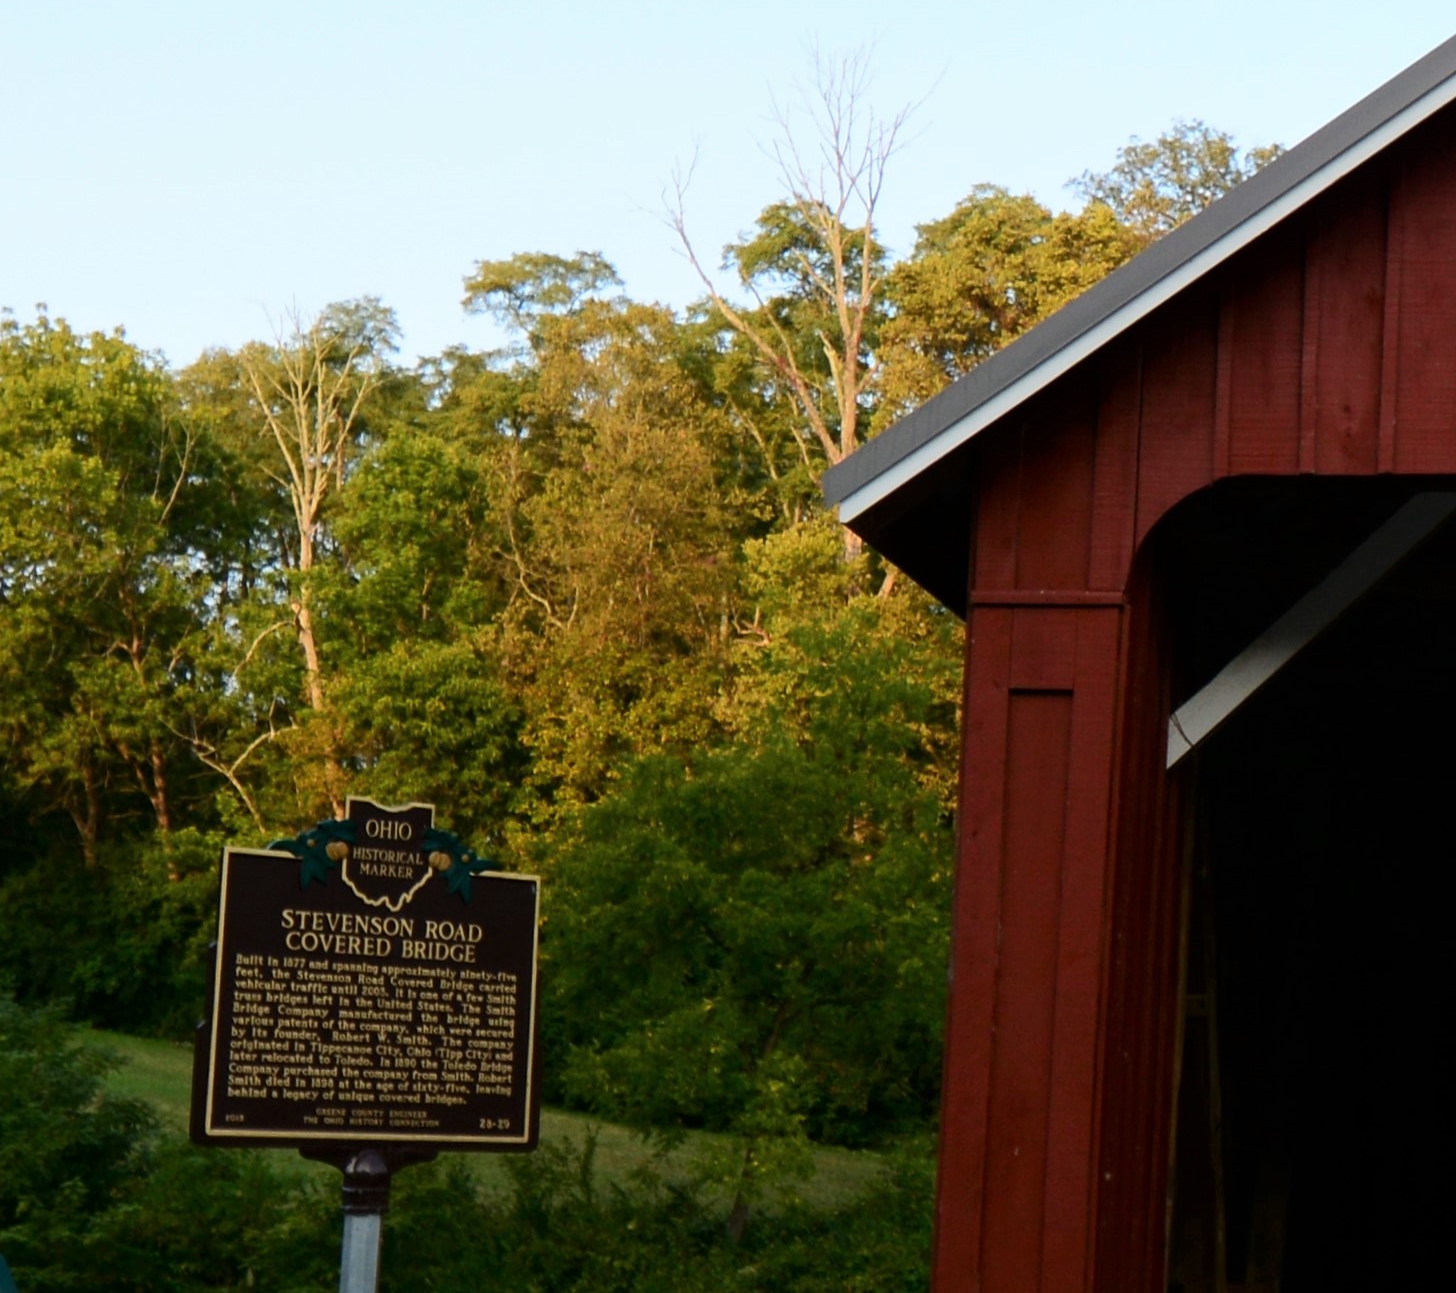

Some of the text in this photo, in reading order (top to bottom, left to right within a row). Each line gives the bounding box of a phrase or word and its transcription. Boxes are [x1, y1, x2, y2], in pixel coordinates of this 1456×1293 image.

[365, 818, 412, 841] OHIO
[353, 847, 423, 865] HISTORICAL
[360, 862, 413, 879] MARKER
[281, 908, 482, 943] STEVENSON ROAD
[285, 930, 475, 963] COVERED BRIDGE
[236, 953, 263, 965] Built
[267, 955, 278, 966] in
[283, 956, 305, 968] 1877
[308, 958, 328, 969] and
[332, 960, 378, 975] spanning
[381, 963, 456, 980] approximately
[235, 977, 286, 990] vehicular
[290, 981, 327, 993] traffic
[331, 983, 357, 995] until
[395, 987, 403, 997] It
[407, 988, 416, 998] is
[419, 991, 438, 1000] one
[442, 990, 453, 1001] of
[456, 993, 462, 1001] a
[466, 992, 483, 1002] few
[486, 993, 516, 1004] Smith
[271, 967, 290, 978] the
[297, 969, 351, 982] Stevenson
[358, 973, 384, 985] Road
[390, 975, 433, 988] Covered
[440, 979, 473, 993] Bridge
[478, 981, 516, 993] carried
[232, 1001, 514, 1029] Bridge Company manufactured the bridge using
[233, 989, 261, 1001] truss
[266, 991, 308, 1005] bridges
[312, 994, 332, 1005] left
[339, 995, 349, 1006] in
[355, 996, 372, 1007] the
[377, 998, 412, 1010] United
[461, 1003, 480, 1014] The
[486, 1005, 515, 1016] Smith
[232, 1013, 273, 1025] various
[277, 1016, 318, 1030] patents
[322, 1018, 334, 1028] of
[337, 1019, 355, 1030] the
[416, 1023, 445, 1034] which
[449, 1027, 471, 1036] were
[475, 1027, 514, 1038] secured
[229, 1037, 289, 1052] originated
[294, 1040, 305, 1051] in
[309, 1041, 372, 1056] Tippecanoe
[495, 1051, 512, 1061] and
[231, 1025, 245, 1038] by
[252, 1026, 267, 1037] its
[332, 1030, 369, 1042] Robert
[441, 1036, 461, 1047] The
[467, 1040, 513, 1052] company
[228, 1061, 279, 1076] Company
[283, 1064, 337, 1078] purchased
[341, 1066, 359, 1077] the
[362, 1069, 408, 1081] company
[412, 1070, 437, 1080] from
[478, 1073, 511, 1083] Robert
[229, 1049, 257, 1060] later
[261, 1051, 313, 1063] relocated
[318, 1053, 330, 1064] to
[380, 1056, 390, 1067] In
[420, 1058, 437, 1069] the
[441, 1059, 476, 1070] Toledo
[480, 1061, 512, 1074] Bridge
[227, 1086, 266, 1097] behind
[271, 1089, 278, 1098] a
[282, 1088, 318, 1101] legacy
[322, 1089, 334, 1100] of
[338, 1090, 374, 1103] unique
[378, 1092, 420, 1103] covered
[228, 1073, 261, 1085] Smith
[265, 1075, 290, 1086] died
[295, 1076, 306, 1087] in
[338, 1078, 349, 1088] at
[354, 1079, 371, 1089] the
[376, 1082, 393, 1092] age
[397, 1081, 409, 1091] of
[475, 1084, 511, 1097] leaving
